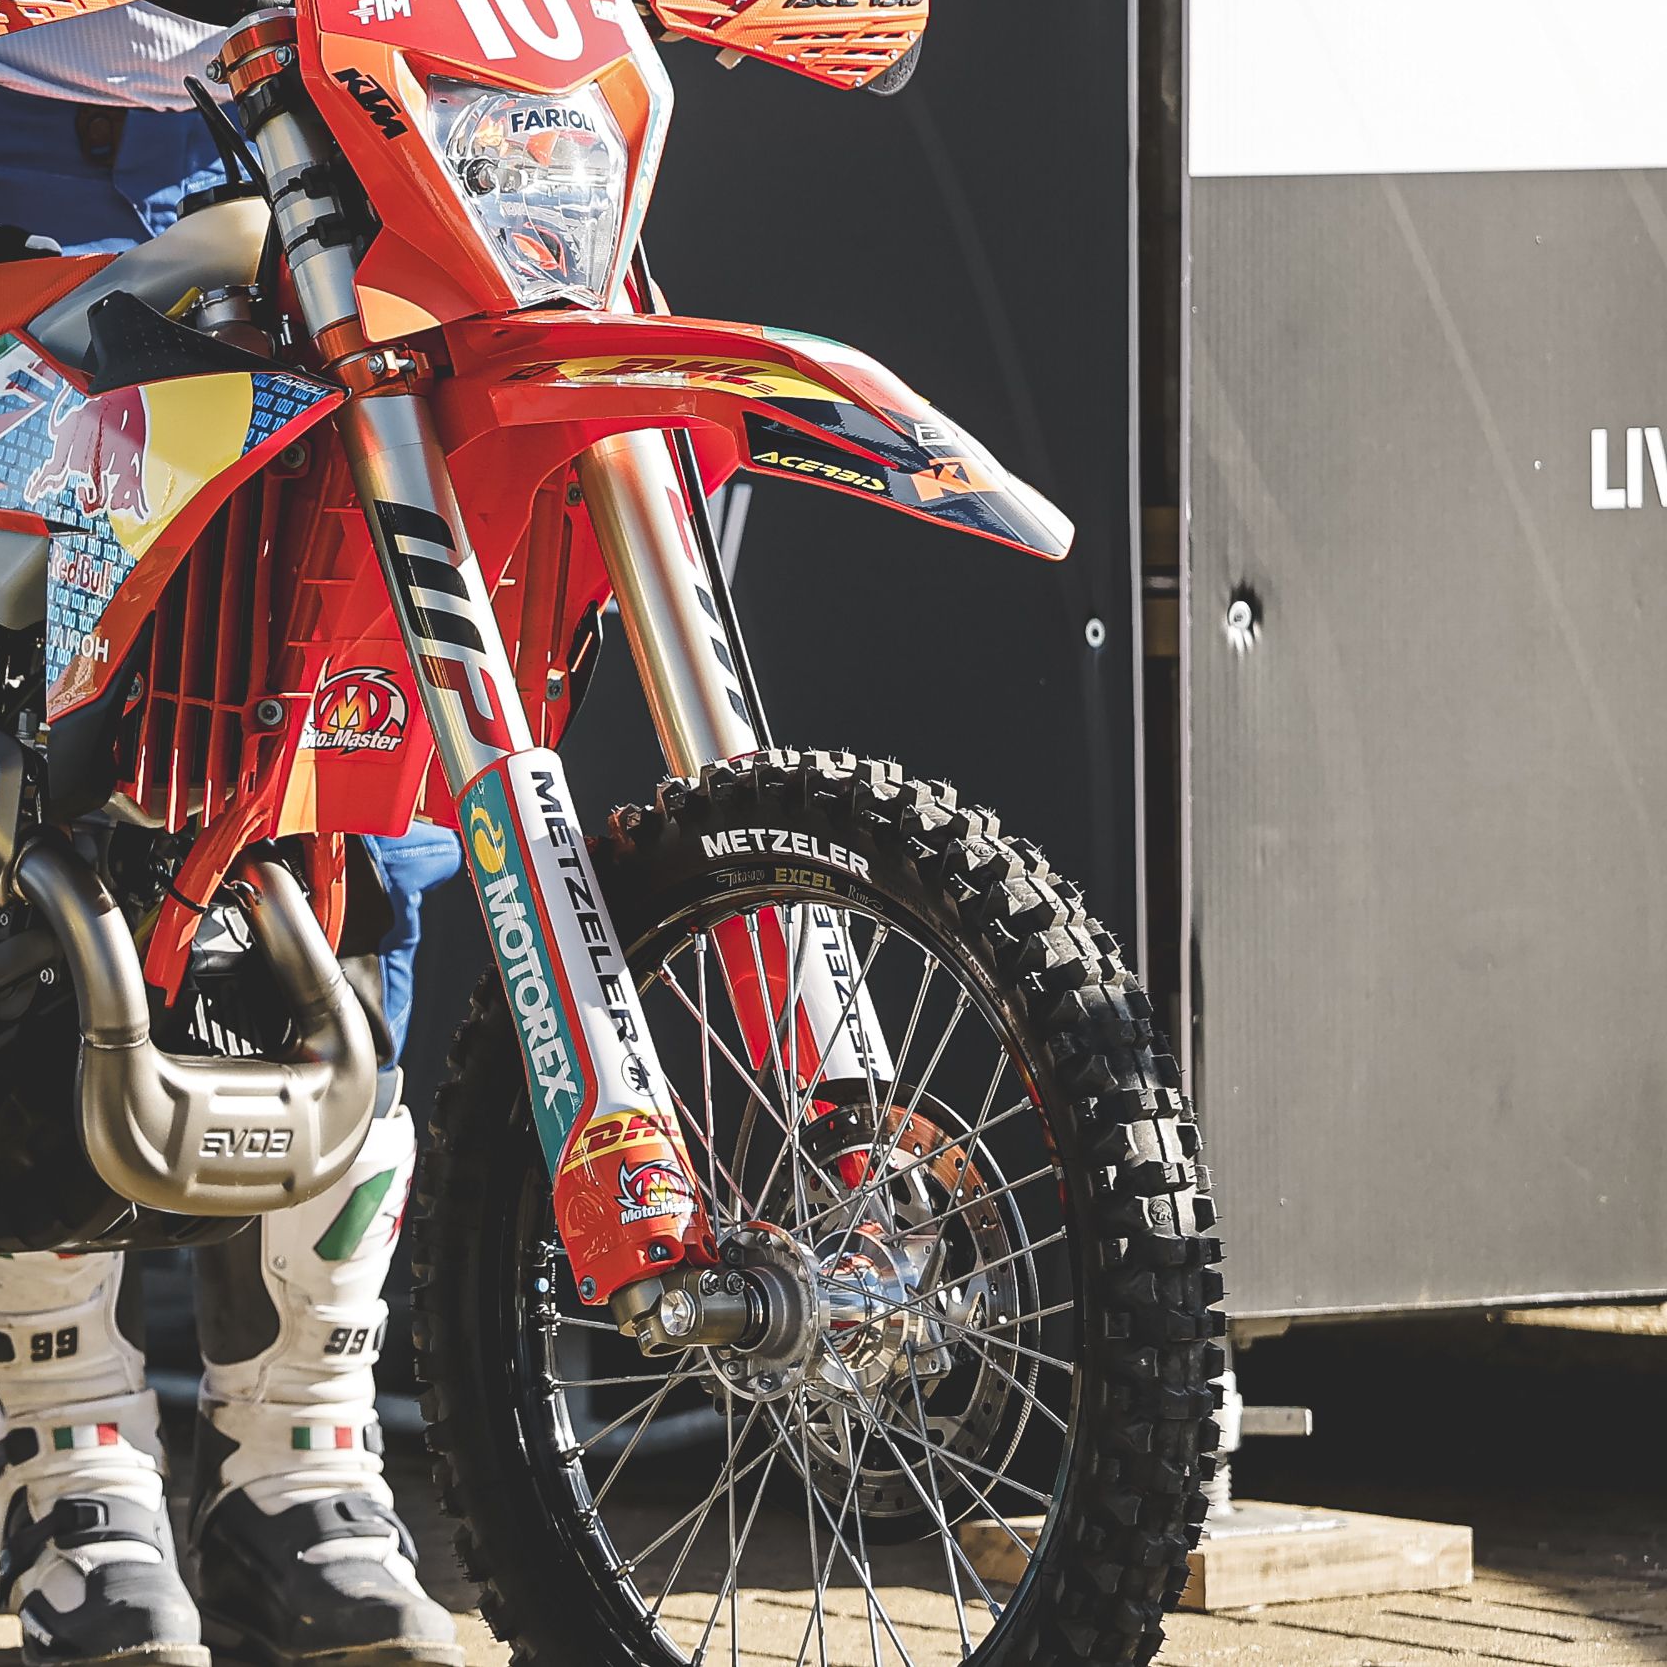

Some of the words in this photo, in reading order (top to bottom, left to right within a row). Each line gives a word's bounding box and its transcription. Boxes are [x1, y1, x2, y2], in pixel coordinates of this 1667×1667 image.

[332, 68, 408, 141] KTM
[753, 451, 887, 491] ACERBIS
[701, 829, 872, 883] METZELER
[775, 867, 837, 891] EXCEL
[531, 770, 639, 1045] METZELER
[483, 874, 578, 1112] MOTOREX
[28, 1327, 79, 1361] 99
[323, 1326, 367, 1357] 99
